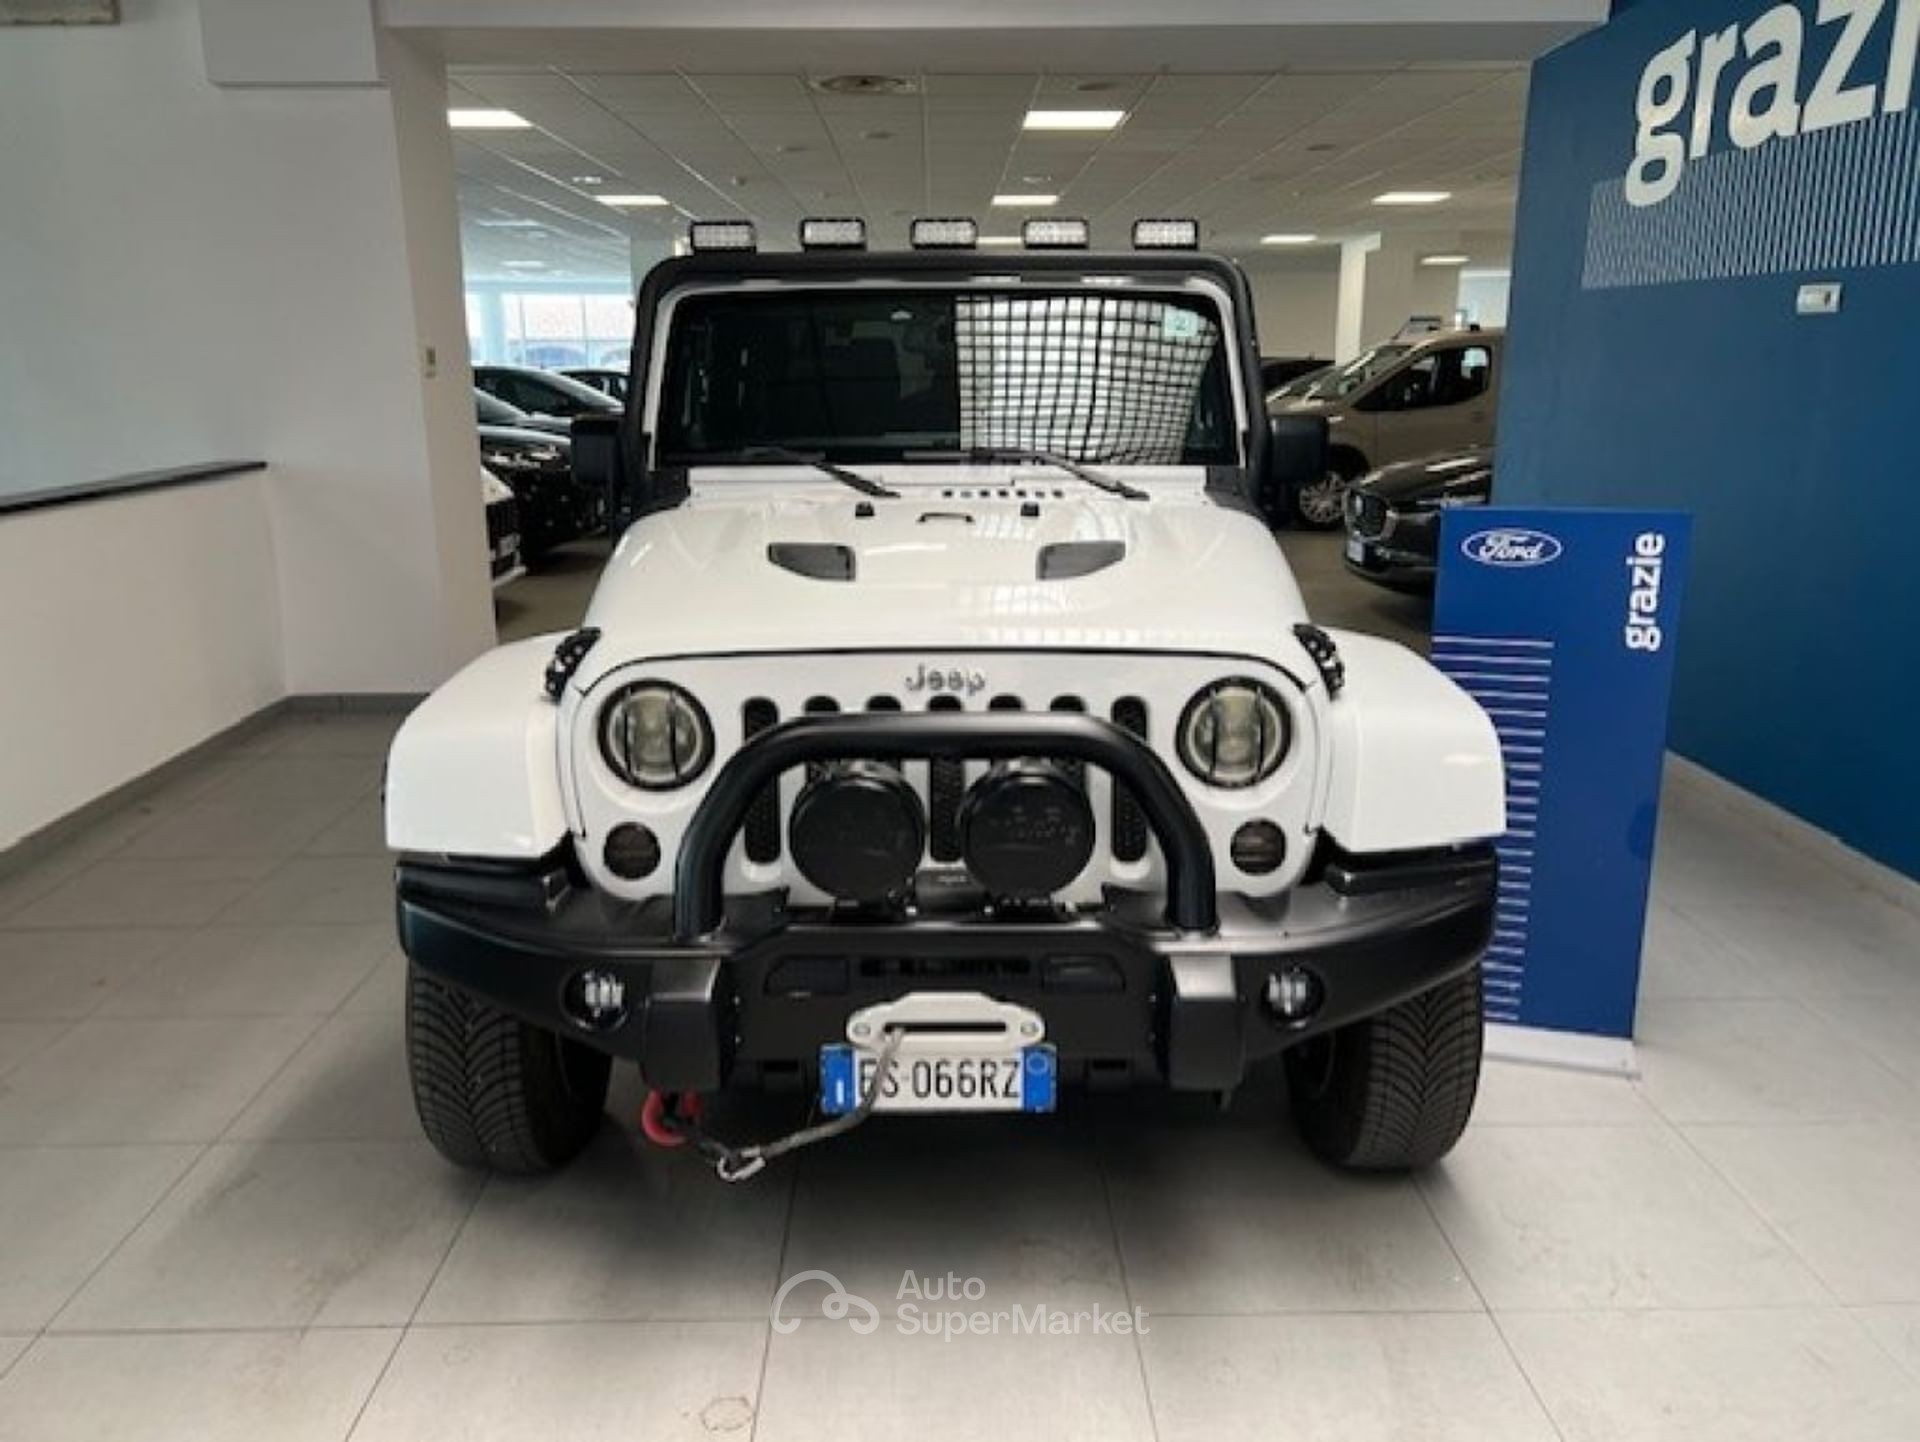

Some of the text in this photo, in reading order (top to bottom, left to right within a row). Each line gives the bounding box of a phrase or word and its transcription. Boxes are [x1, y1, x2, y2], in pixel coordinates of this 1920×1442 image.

[1478, 531, 1544, 562] Ford
[1625, 531, 1666, 651] grazie
[905, 664, 986, 696] Jeep
[911, 1058, 1021, 1099] 066RZ
